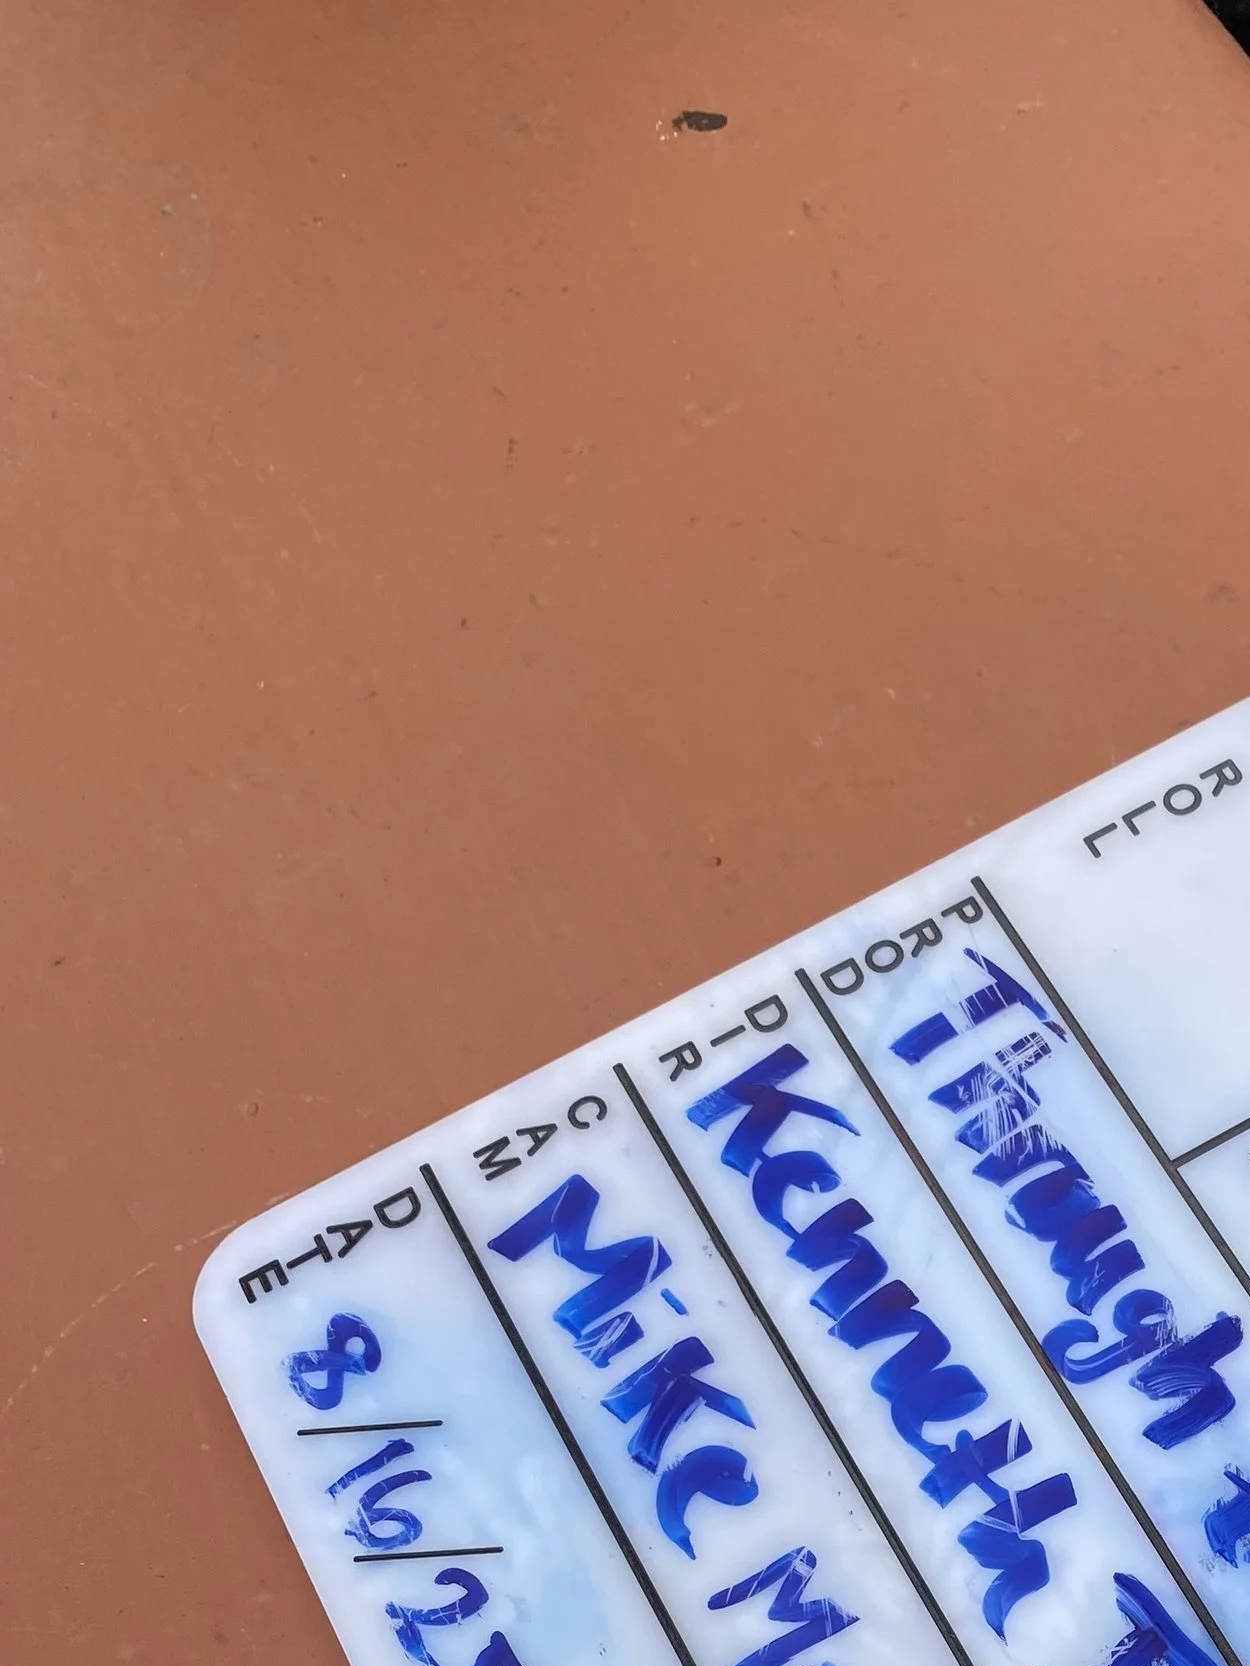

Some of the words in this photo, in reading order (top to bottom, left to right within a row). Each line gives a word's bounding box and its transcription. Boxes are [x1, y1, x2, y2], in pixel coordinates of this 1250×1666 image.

[1083, 758, 1243, 859] ROLL
[820, 896, 983, 997] PROD
[658, 995, 788, 1082] DIR
[473, 1095, 608, 1181] CAM
[238, 1187, 421, 1304] DATE
[889, 947, 1245, 1450] Through
[686, 1043, 1077, 1645] Kenneth
